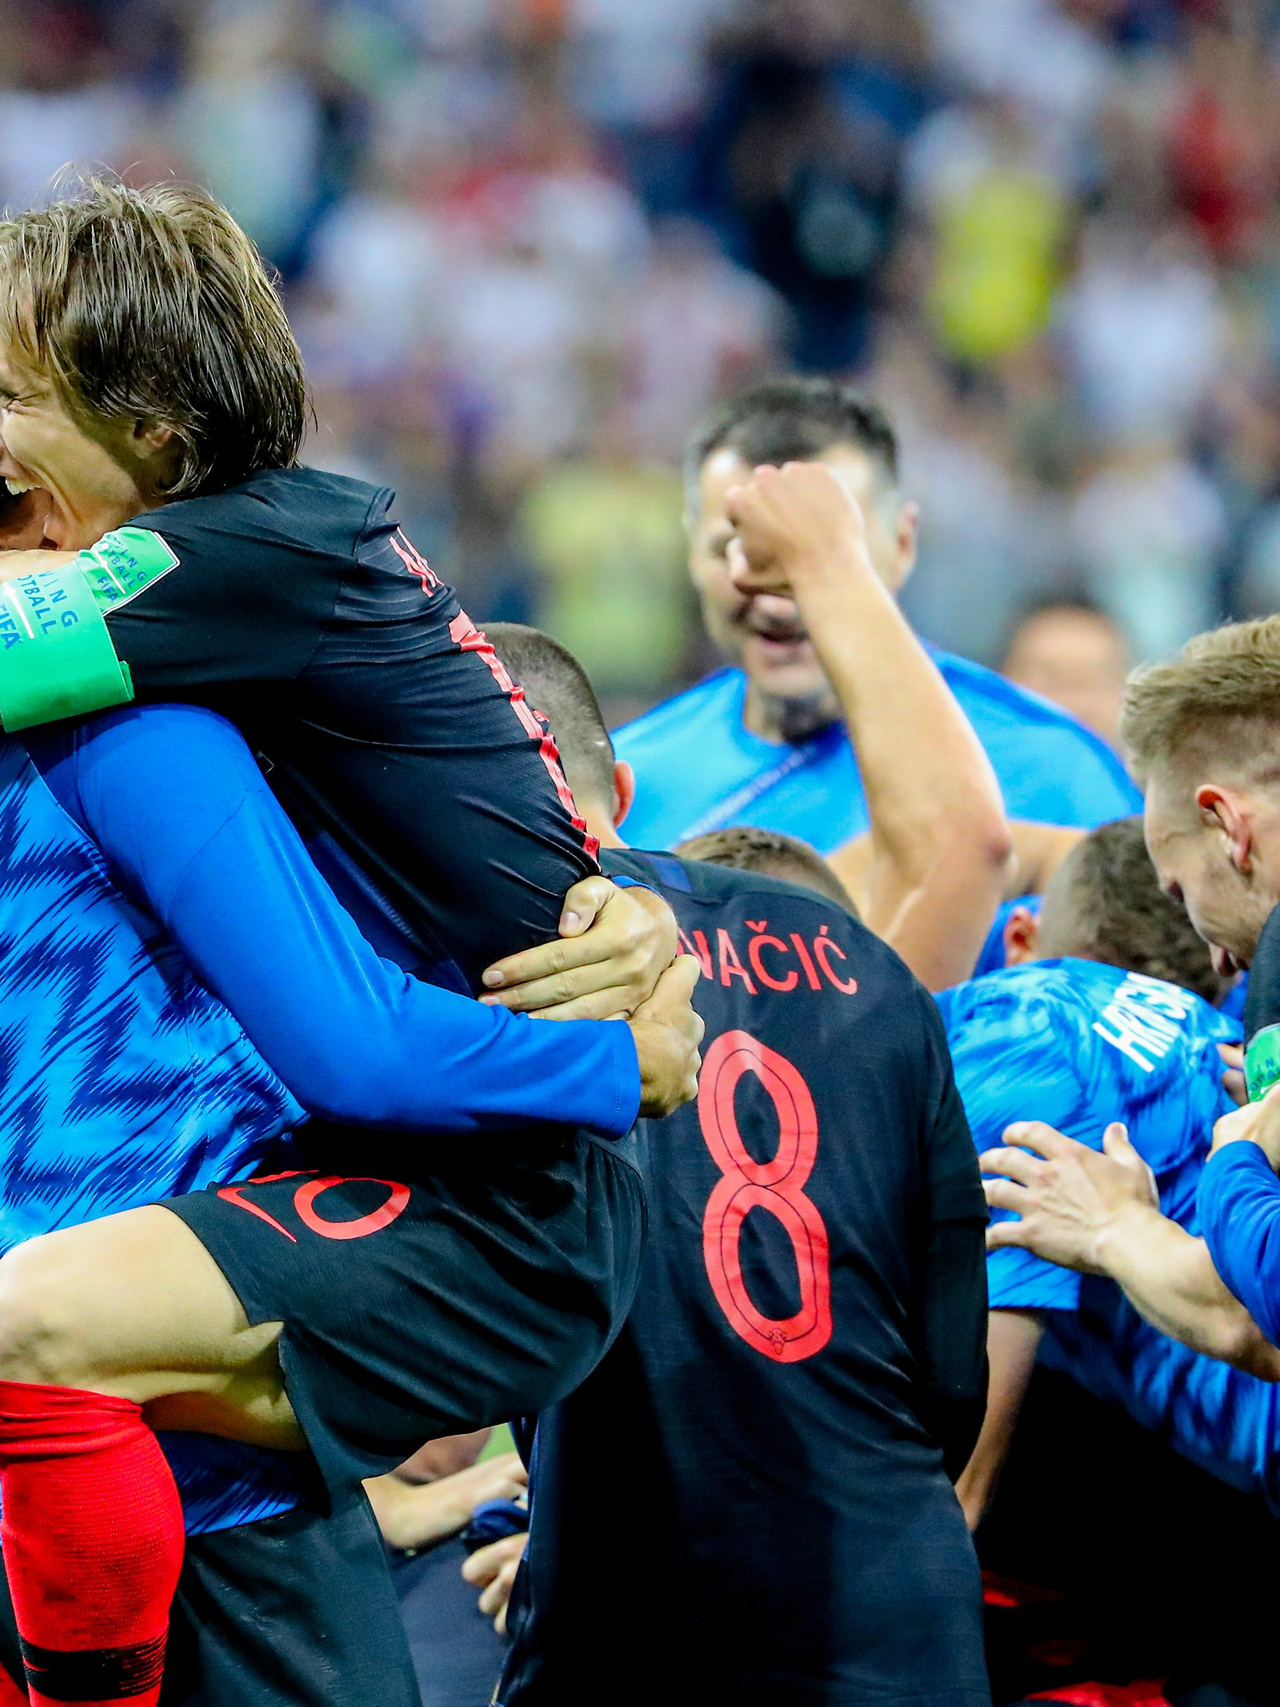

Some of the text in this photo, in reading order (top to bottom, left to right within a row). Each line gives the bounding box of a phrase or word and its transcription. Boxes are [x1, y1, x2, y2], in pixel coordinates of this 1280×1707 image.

[97, 575, 119, 604] FIFA
[677, 919, 858, 995] VAČIĆ
[698, 1029, 832, 1364] 8
